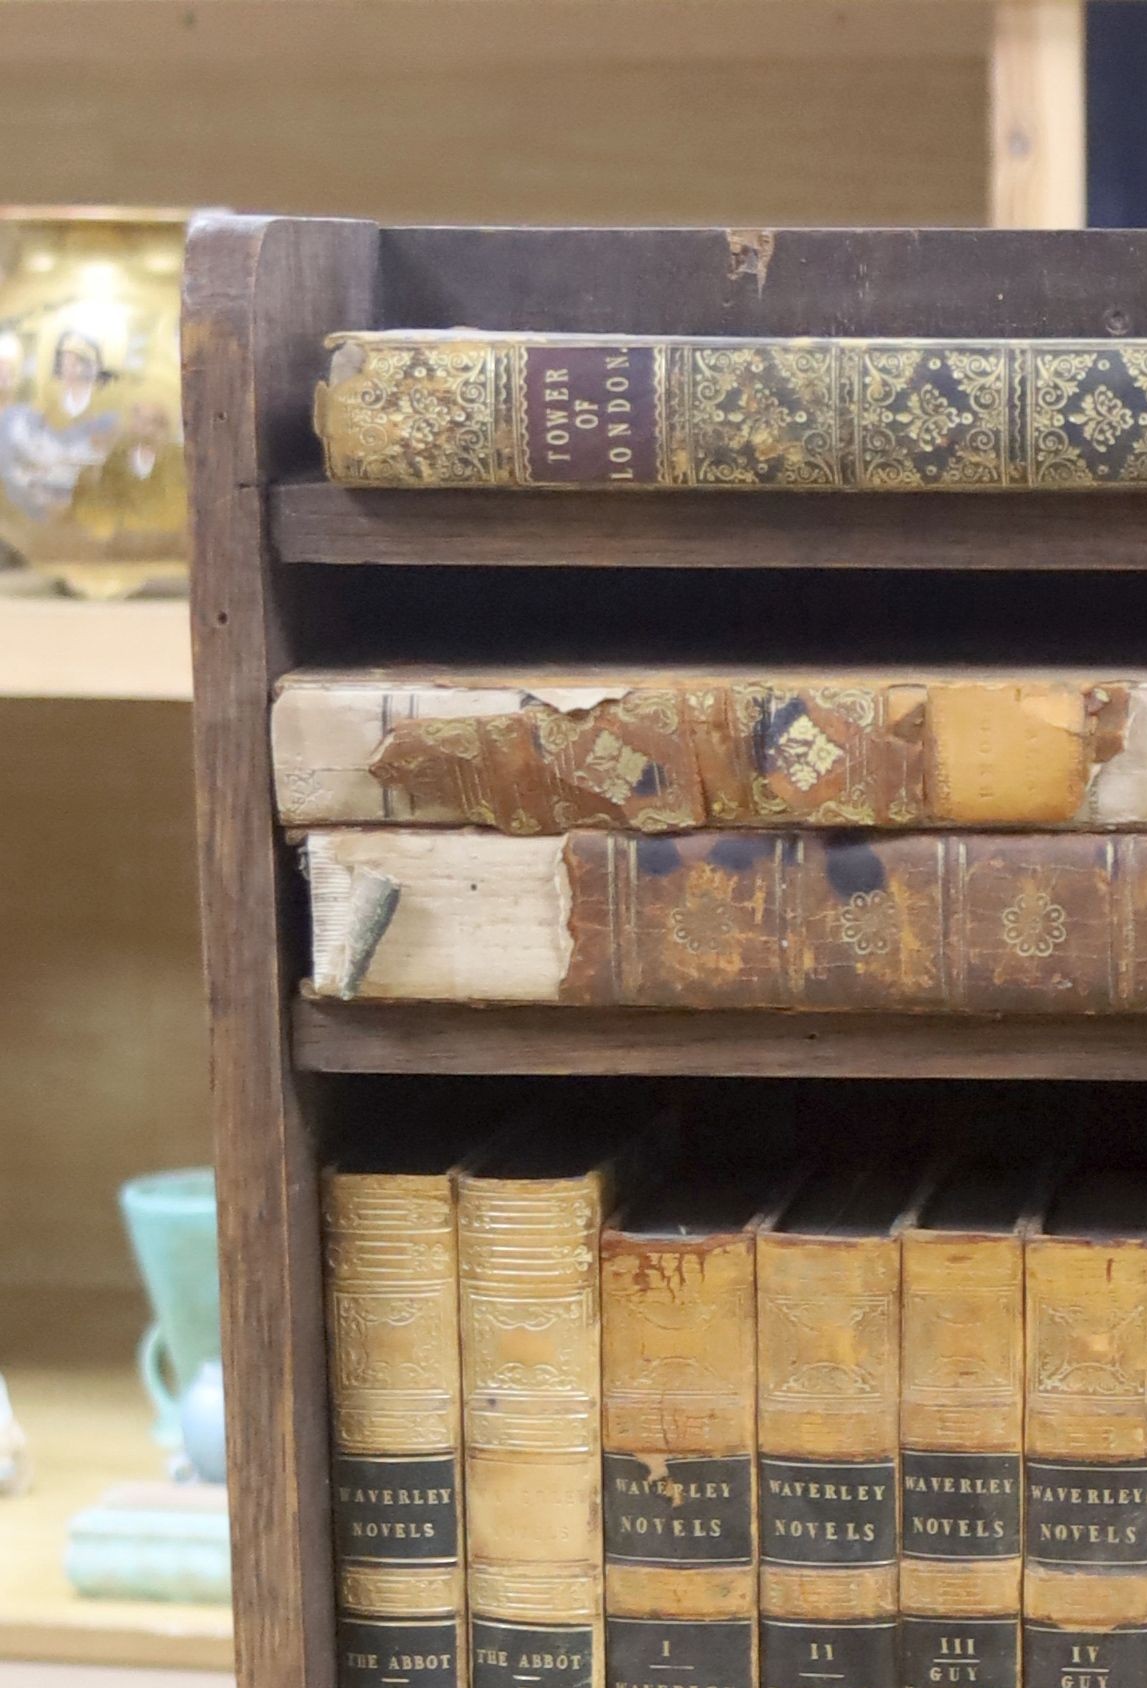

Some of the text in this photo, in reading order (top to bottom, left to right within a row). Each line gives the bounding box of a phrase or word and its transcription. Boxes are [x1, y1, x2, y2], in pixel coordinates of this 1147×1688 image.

[547, 367, 571, 464] TOWER
[575, 399, 600, 430] OF
[606, 347, 630, 480] LONDON.
[615, 1478, 731, 1499] WAVERLEY
[769, 1478, 886, 1501] WAVERLEY
[905, 1476, 1015, 1495] WAVERLEY
[1031, 1484, 1143, 1504] WAVERLEY
[340, 1487, 452, 1505] WAVERLEY
[352, 1522, 435, 1539] NOVELS
[619, 1516, 721, 1538] NOVELS
[774, 1519, 876, 1542] NOVELS
[912, 1516, 1005, 1539] NOVELS
[1040, 1523, 1137, 1545] NOVELS
[661, 1640, 671, 1657] I
[809, 1642, 835, 1661] II
[939, 1637, 976, 1655] III
[1071, 1645, 1099, 1663] IV
[347, 1653, 451, 1671] THE ABBOT
[477, 1649, 581, 1671] THE ABBOT
[929, 1666, 978, 1682] GUY
